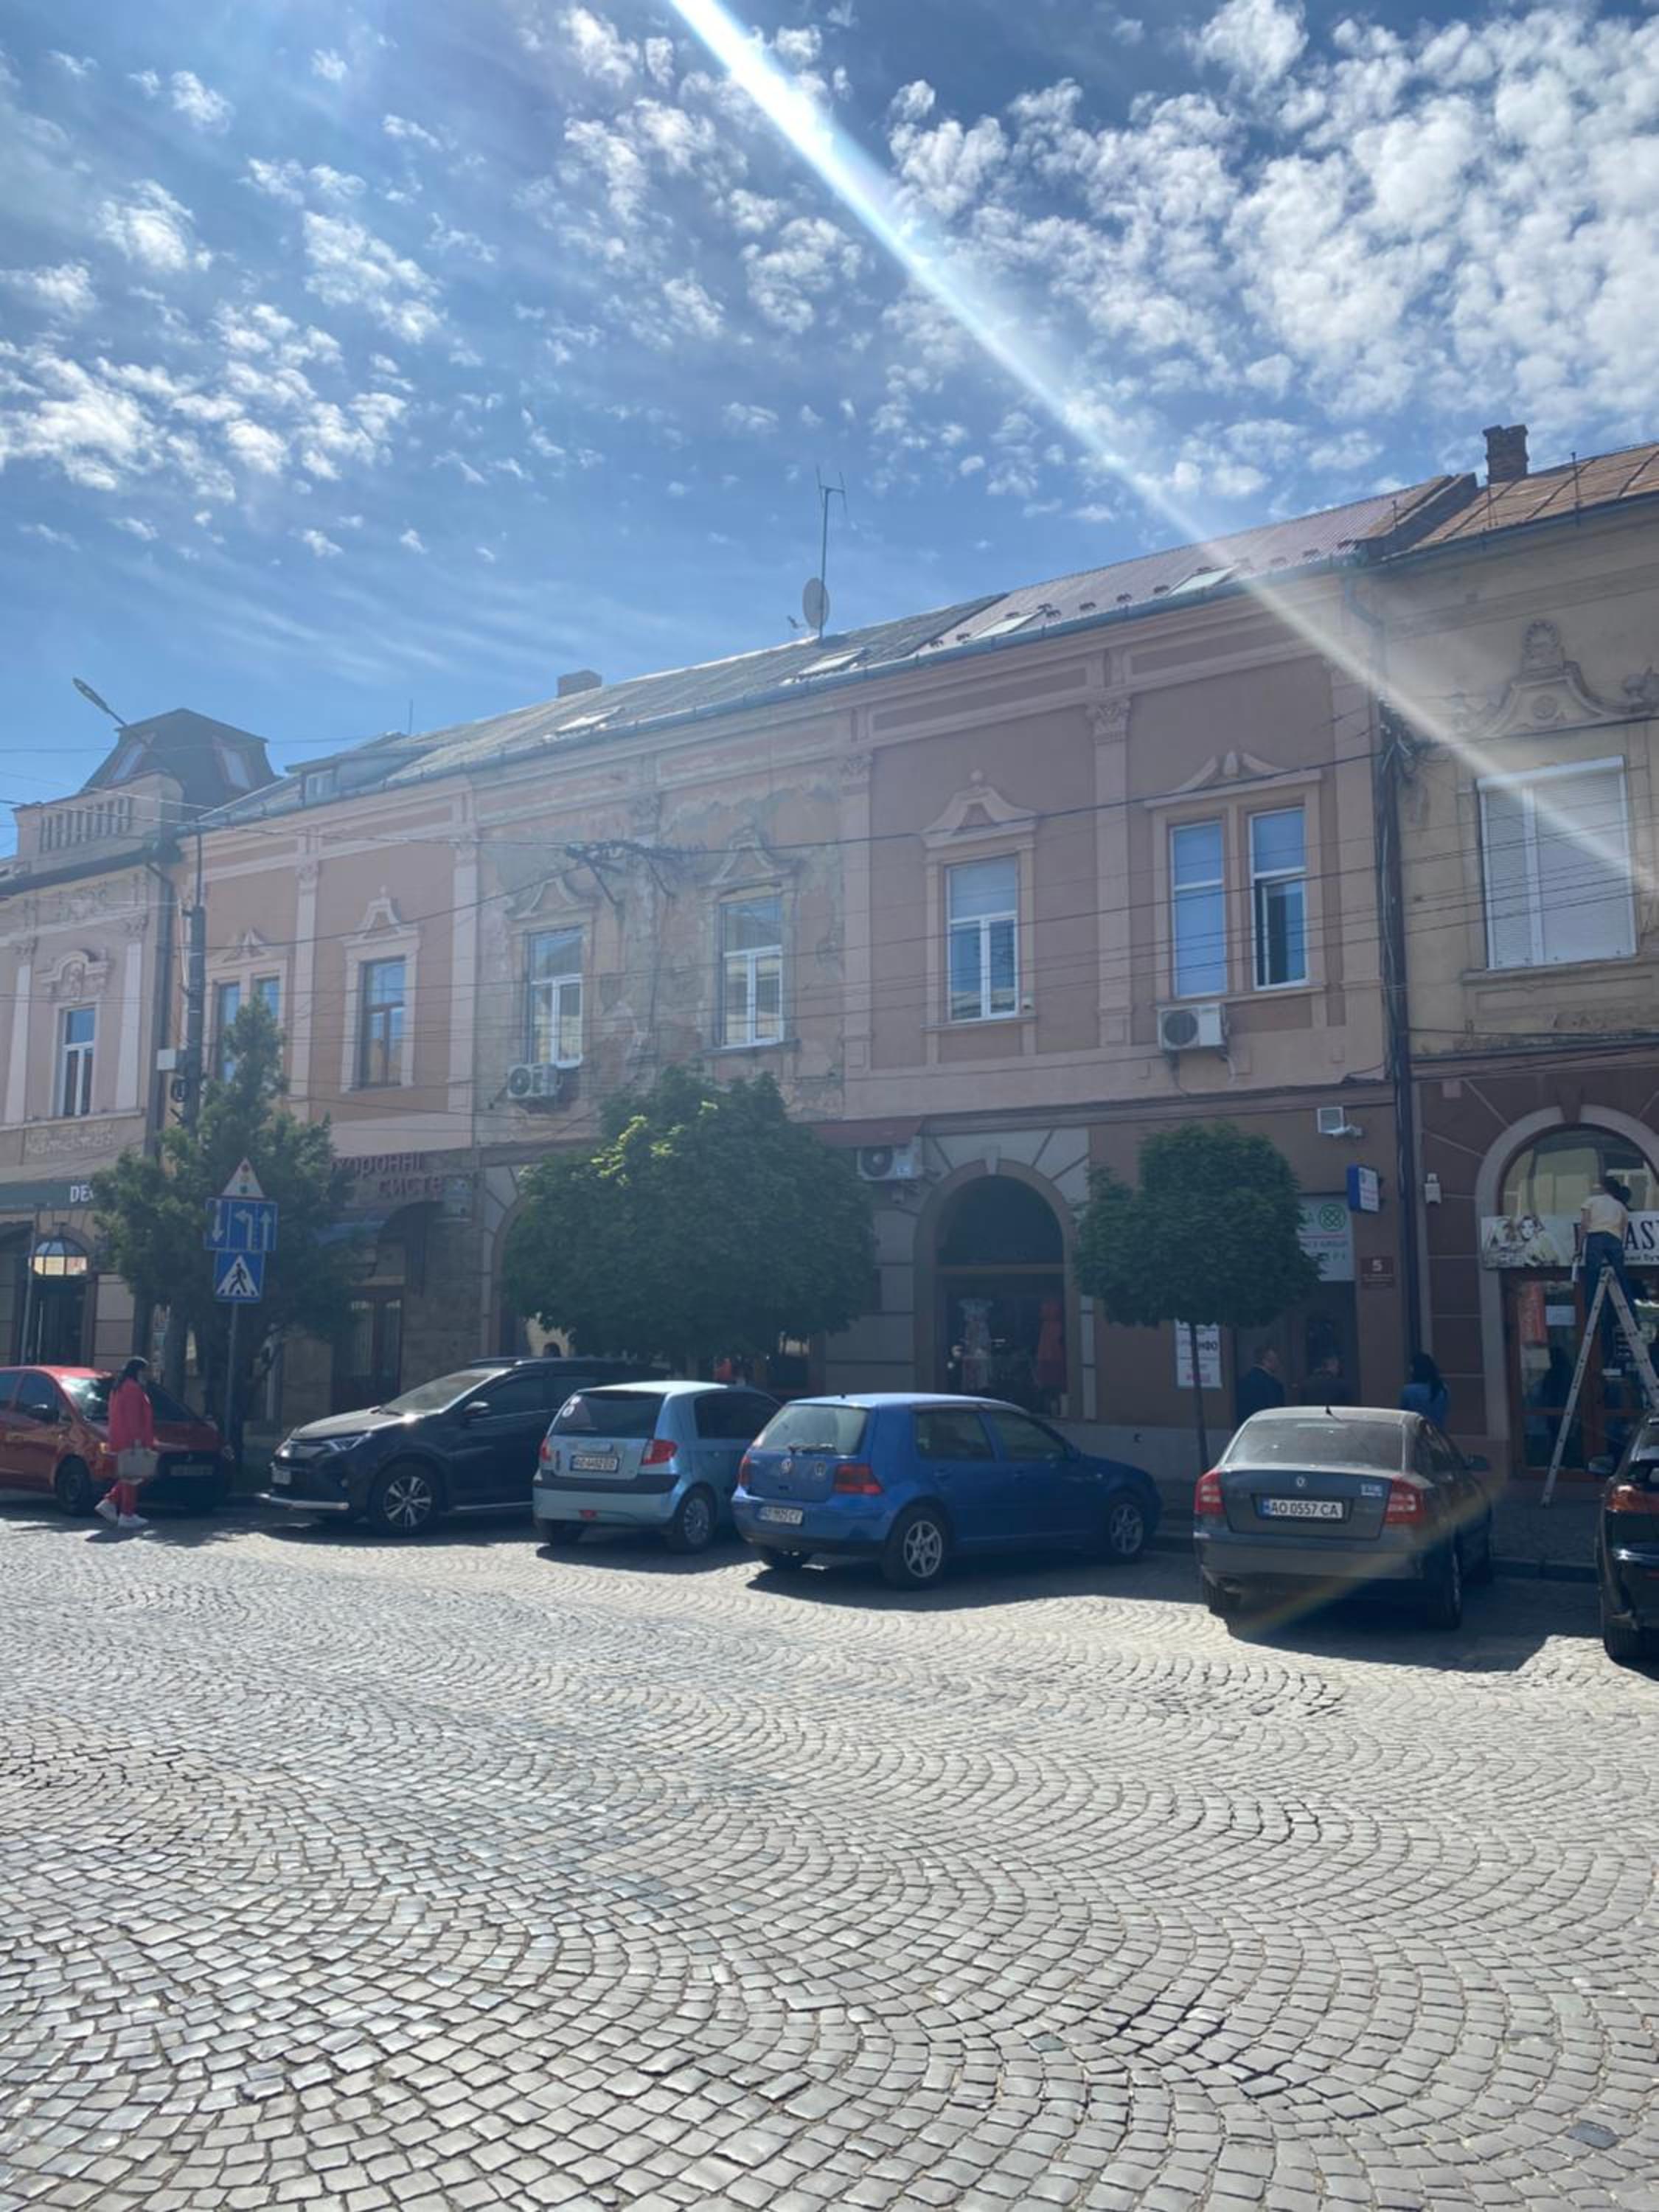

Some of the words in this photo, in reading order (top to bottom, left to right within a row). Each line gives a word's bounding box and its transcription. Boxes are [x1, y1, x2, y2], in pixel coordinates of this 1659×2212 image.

[70, 1185, 94, 1203] DE
[1371, 1259, 1383, 1272] 5
[1290, 1501, 1318, 1514] 0557
[1320, 1503, 1339, 1516] CA
